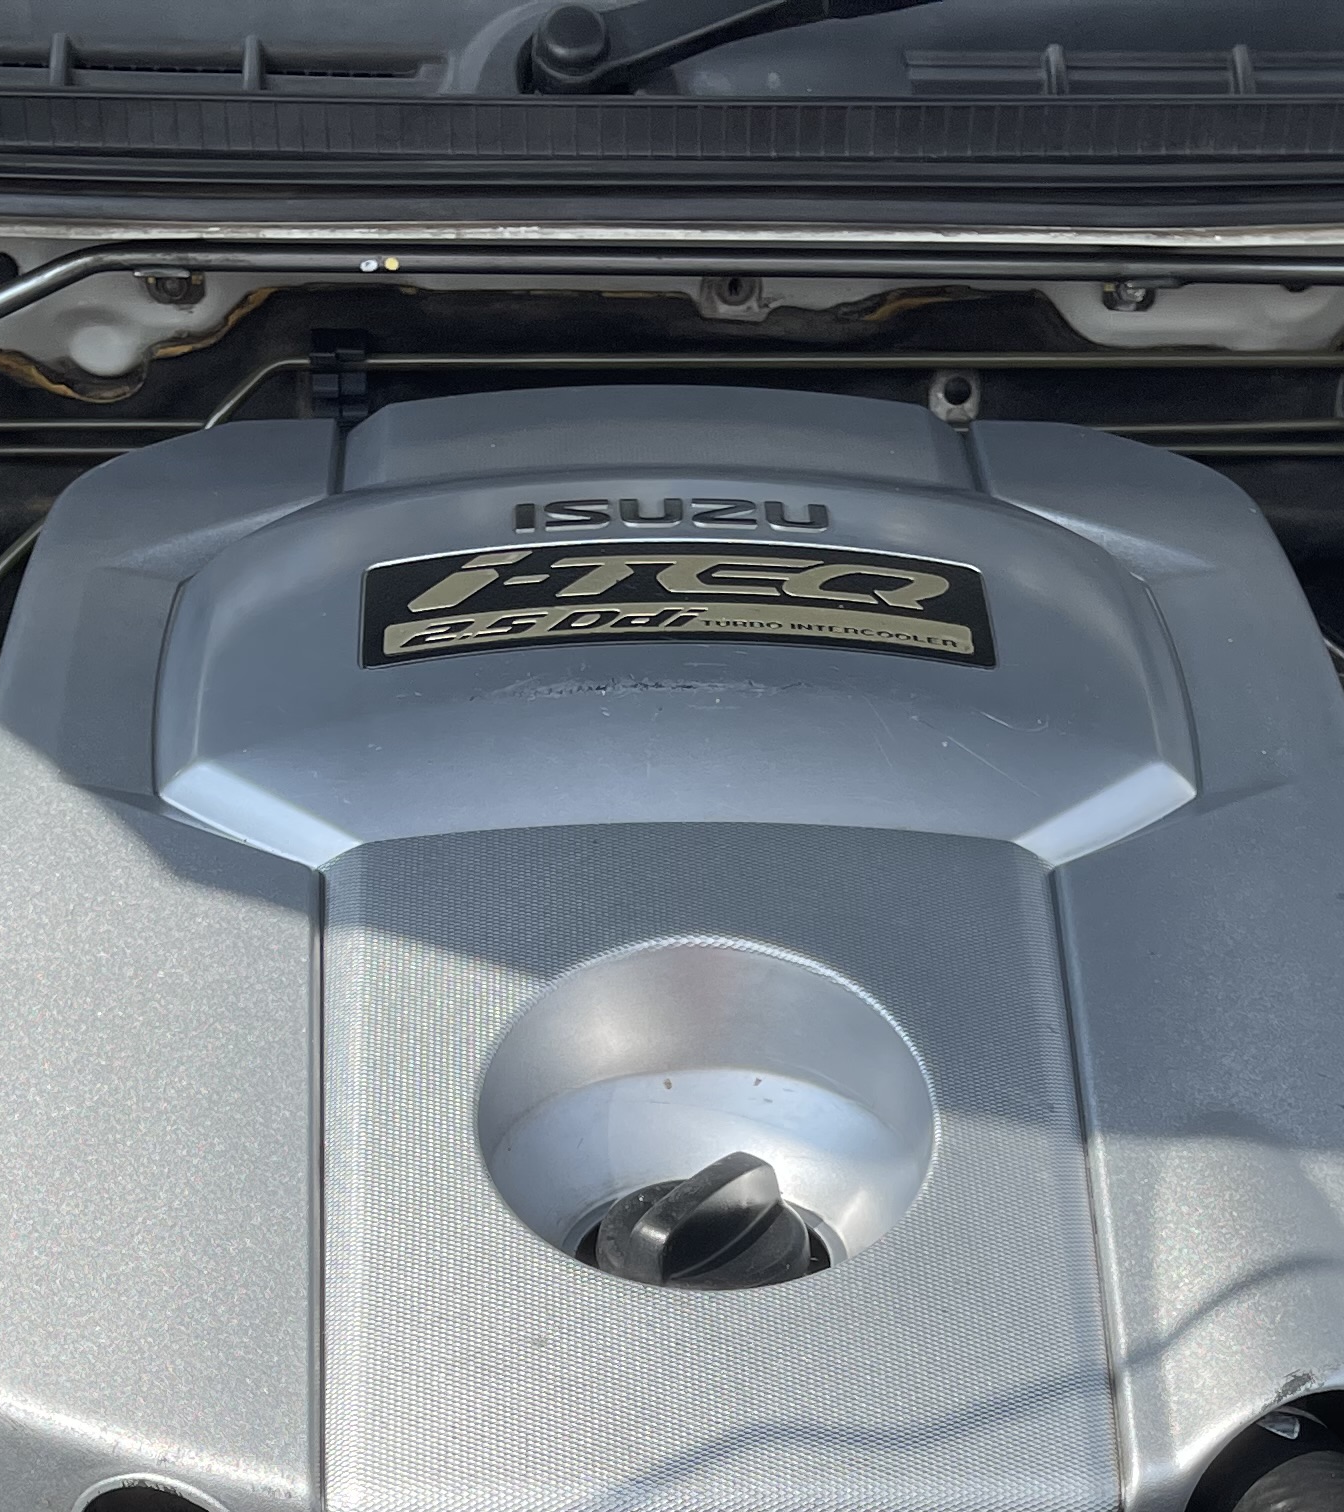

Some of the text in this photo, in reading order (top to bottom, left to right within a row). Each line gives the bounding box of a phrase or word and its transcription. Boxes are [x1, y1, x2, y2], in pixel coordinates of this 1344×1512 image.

[514, 498, 829, 534] ISUZU
[701, 617, 784, 631] TURBO
[789, 622, 960, 648] INTERCOOLER
